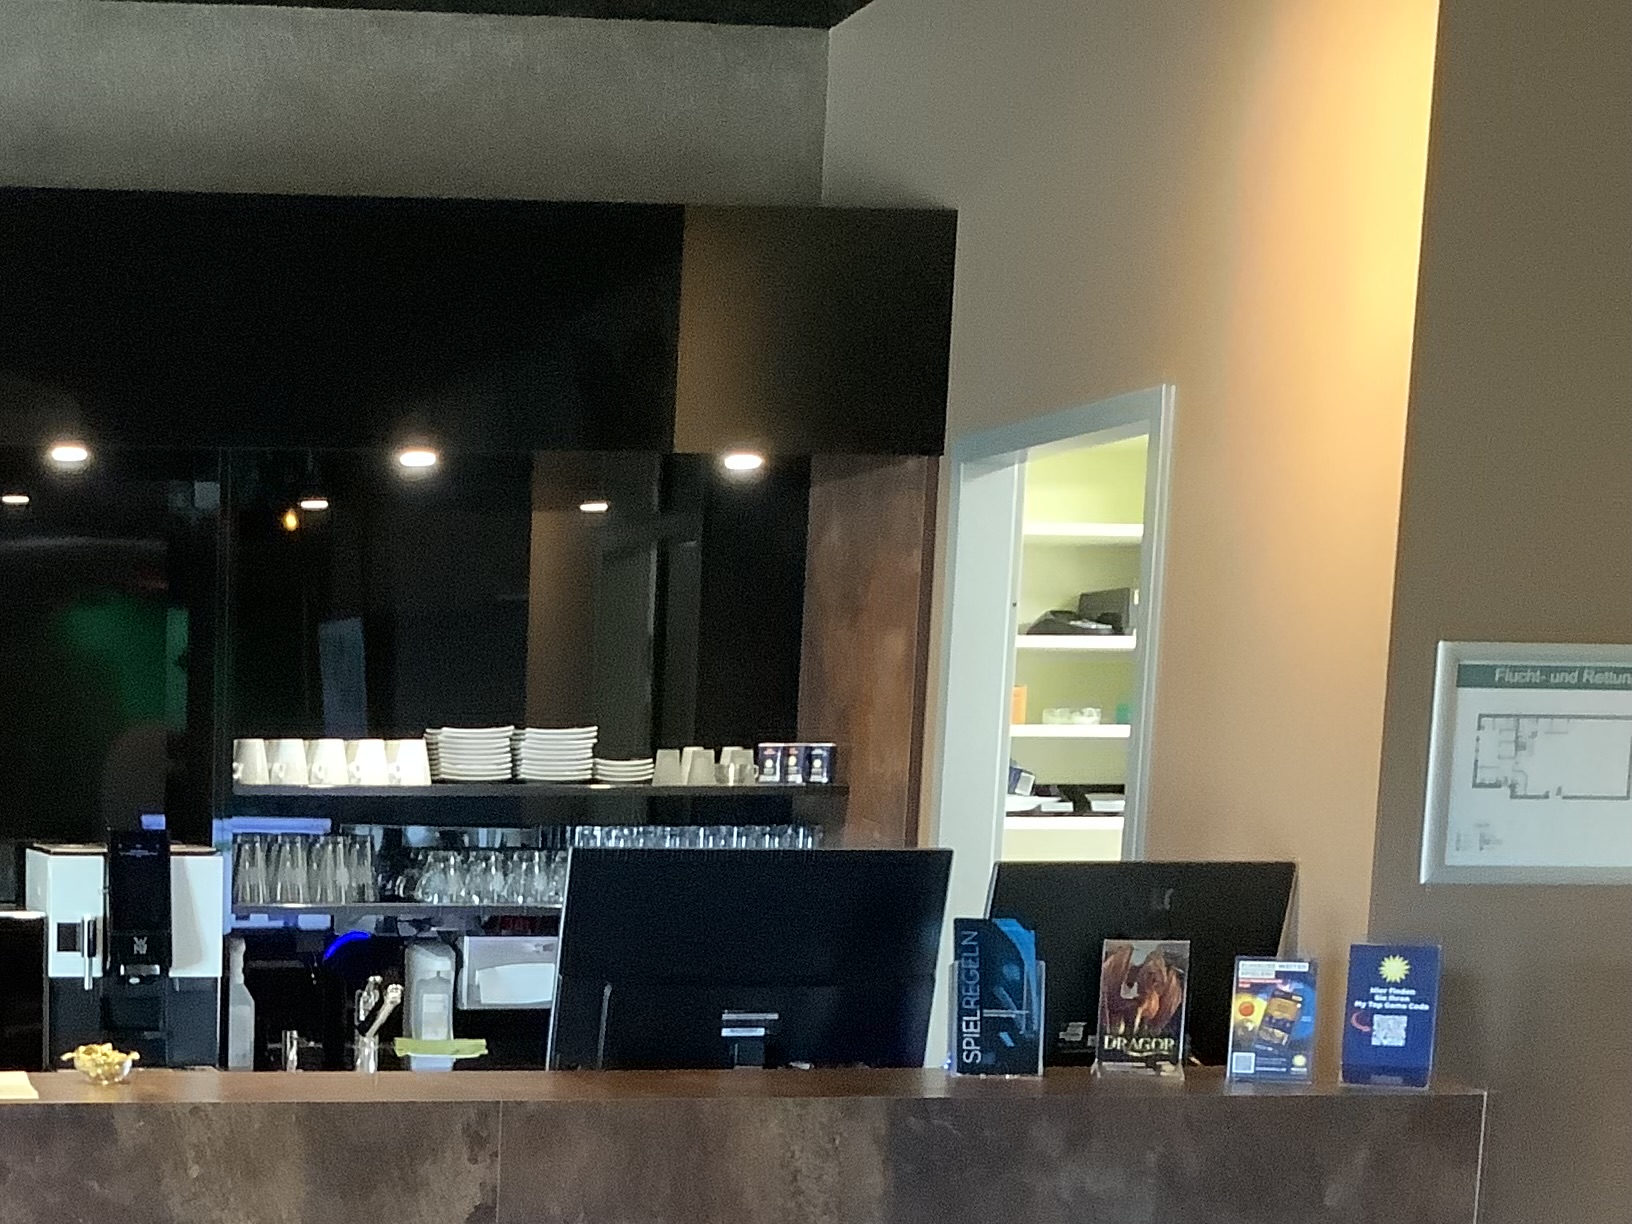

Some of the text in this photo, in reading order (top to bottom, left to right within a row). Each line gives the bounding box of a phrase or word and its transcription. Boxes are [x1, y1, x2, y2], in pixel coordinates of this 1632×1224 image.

[1494, 668, 1546, 684] Flucht-
[1550, 670, 1579, 685] und
[962, 931, 981, 1064] SPIELREGELN
